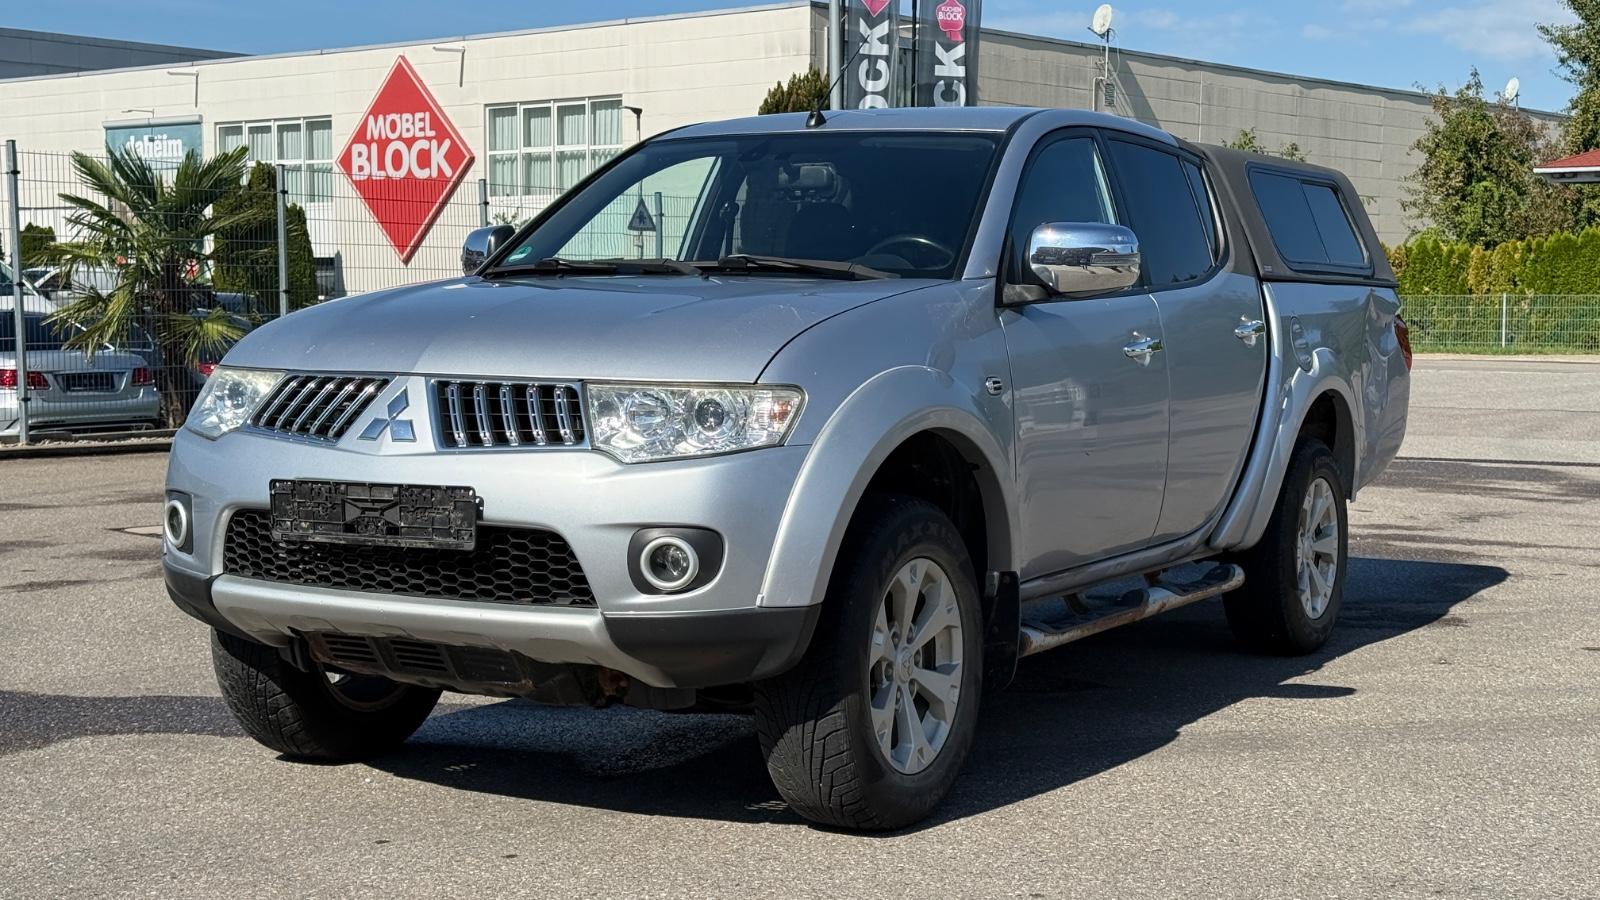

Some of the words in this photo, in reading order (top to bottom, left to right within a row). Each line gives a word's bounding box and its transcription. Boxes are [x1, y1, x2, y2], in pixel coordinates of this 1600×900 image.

[938, 11, 963, 20] BLOCK
[366, 112, 436, 140] MÖBEL
[351, 138, 453, 181] BLOCK
